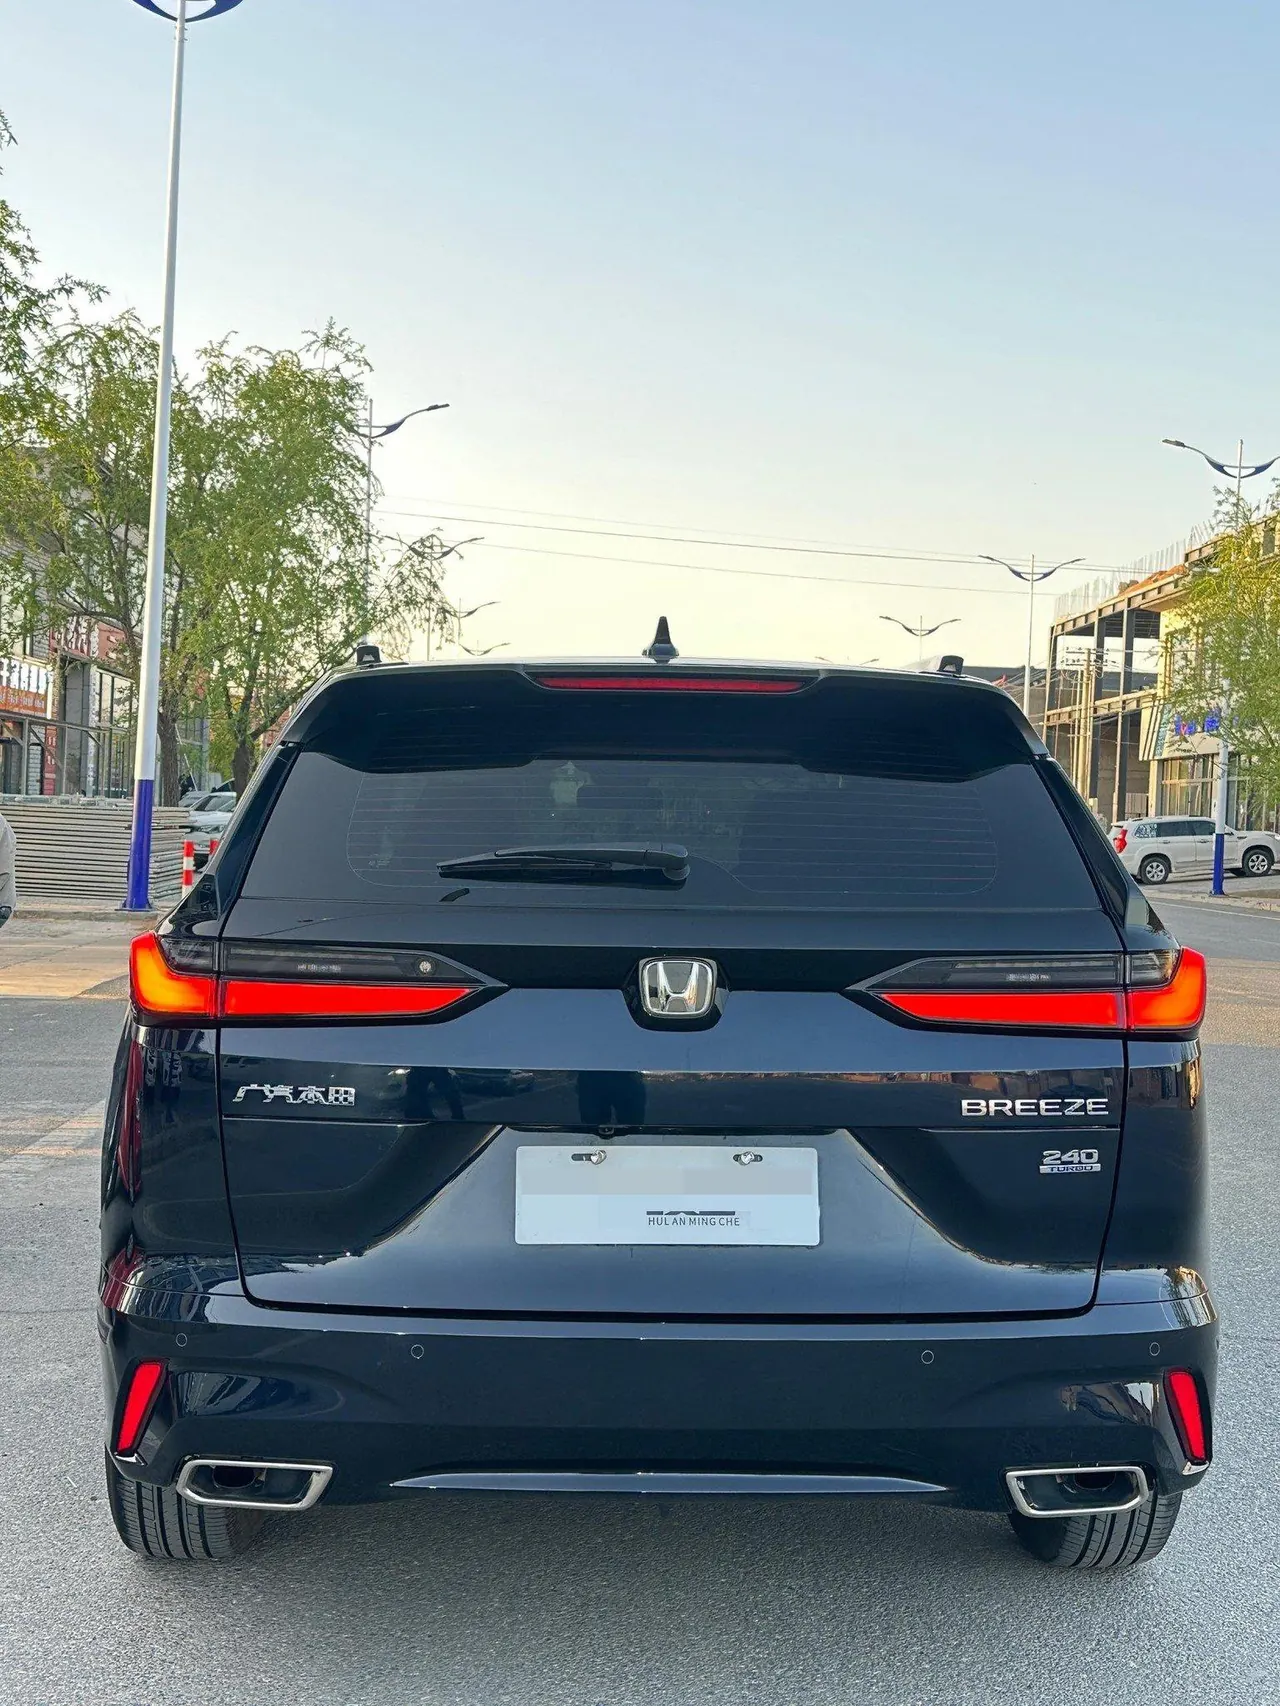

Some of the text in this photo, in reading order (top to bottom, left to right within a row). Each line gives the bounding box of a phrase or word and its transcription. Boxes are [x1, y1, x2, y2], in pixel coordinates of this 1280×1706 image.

[961, 1099, 1109, 1117] BREEZE
[1042, 1149, 1099, 1165] 240
[1048, 1165, 1094, 1173] TURBO
